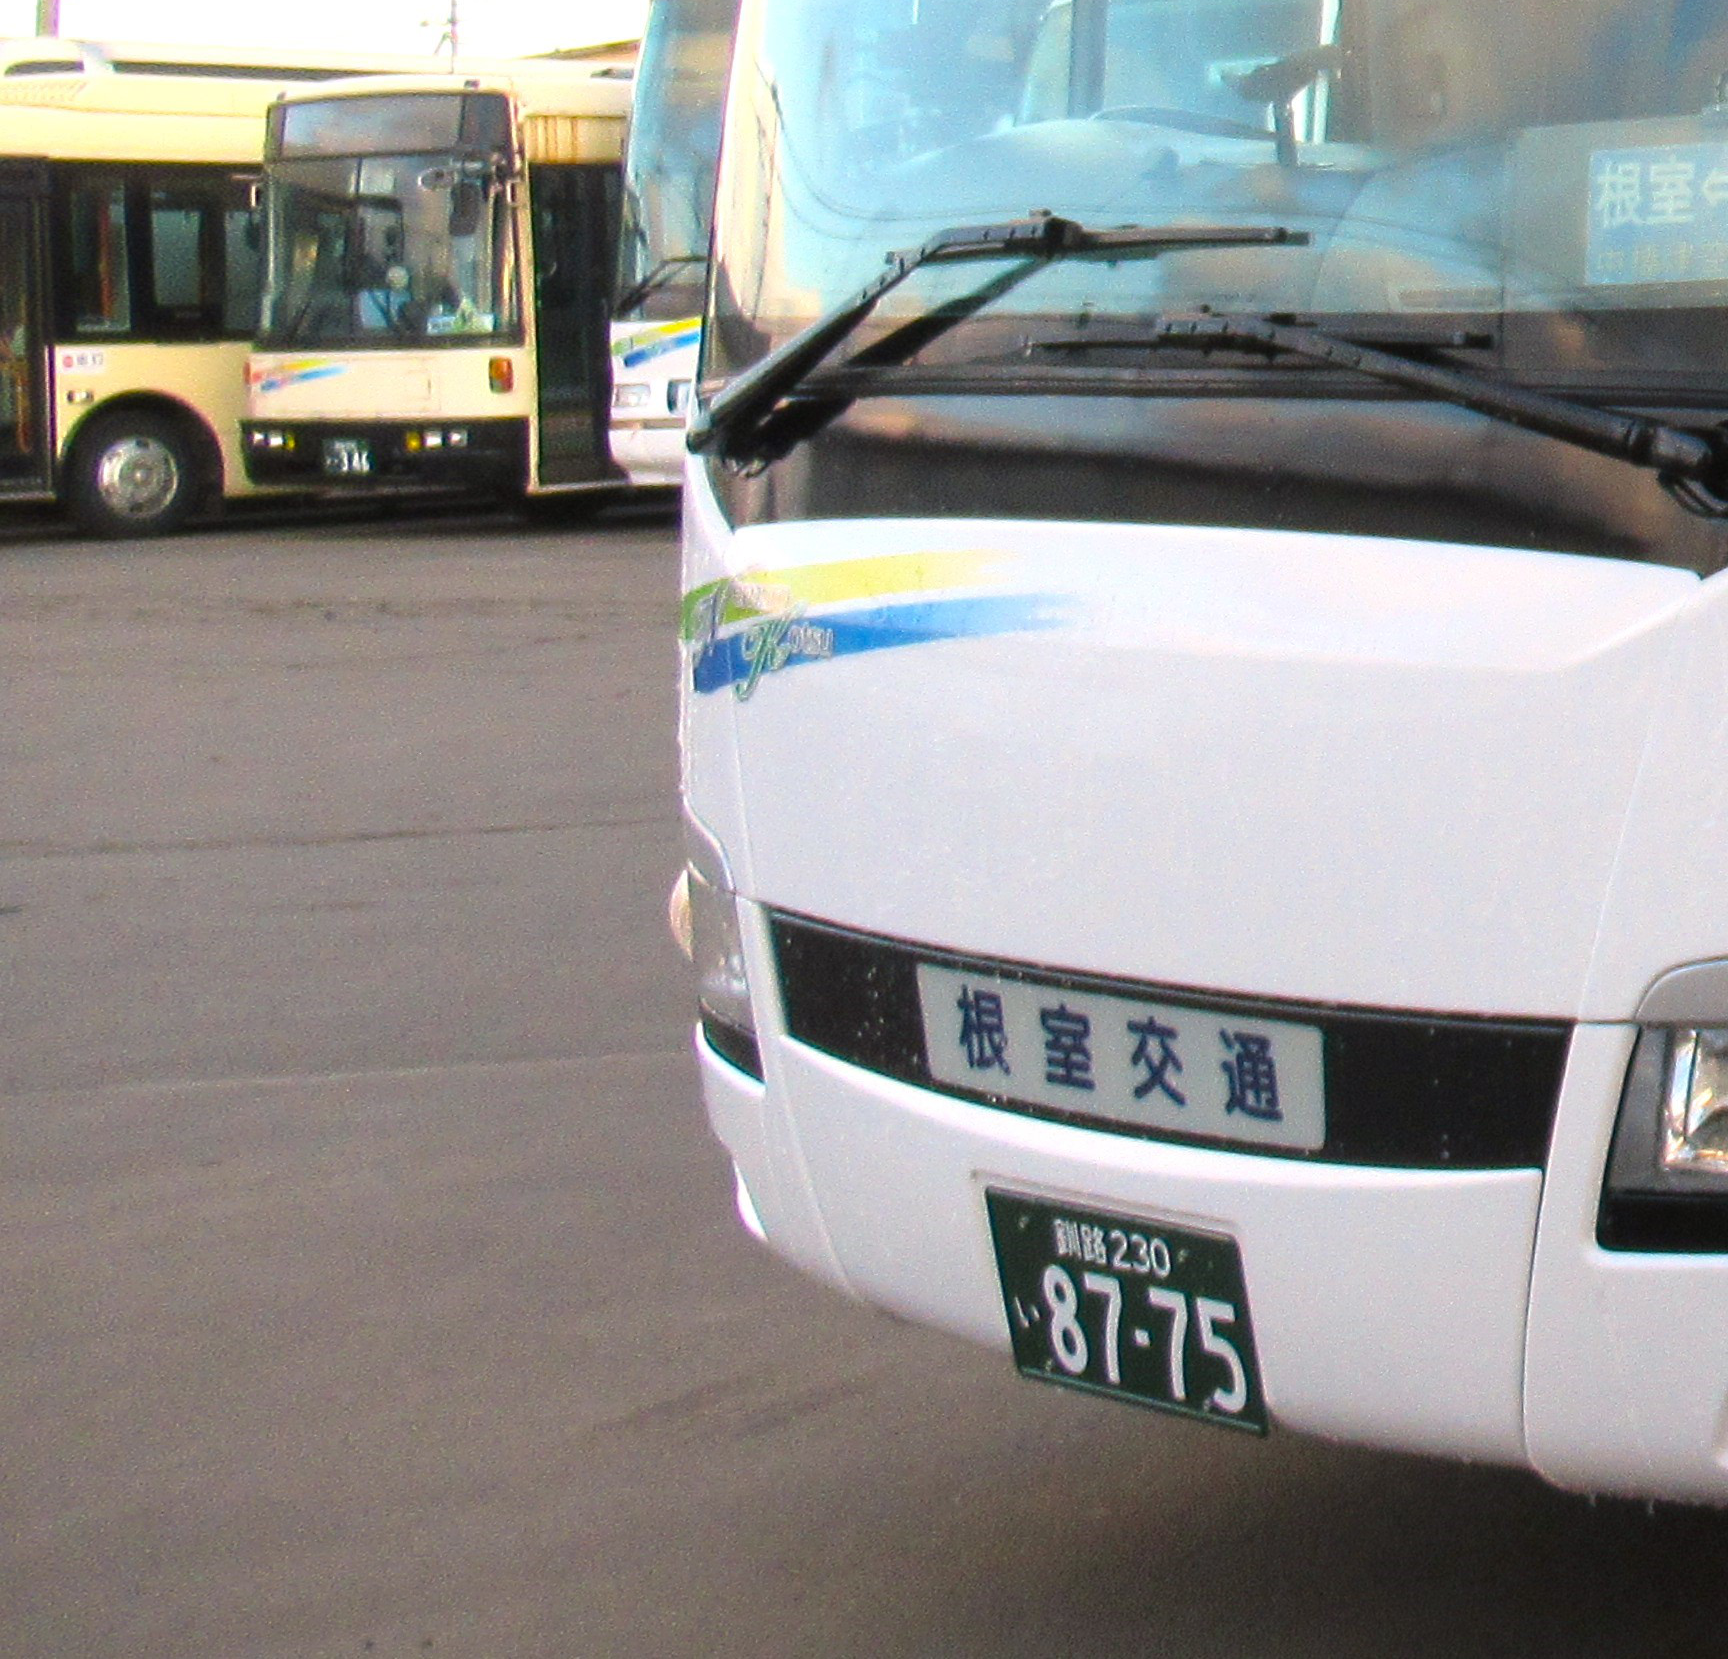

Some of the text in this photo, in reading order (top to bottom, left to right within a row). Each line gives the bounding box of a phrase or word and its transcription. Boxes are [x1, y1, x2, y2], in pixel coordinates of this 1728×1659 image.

[957, 984, 1283, 1121] 根室交通
[1042, 1263, 1247, 1413] 87-75
